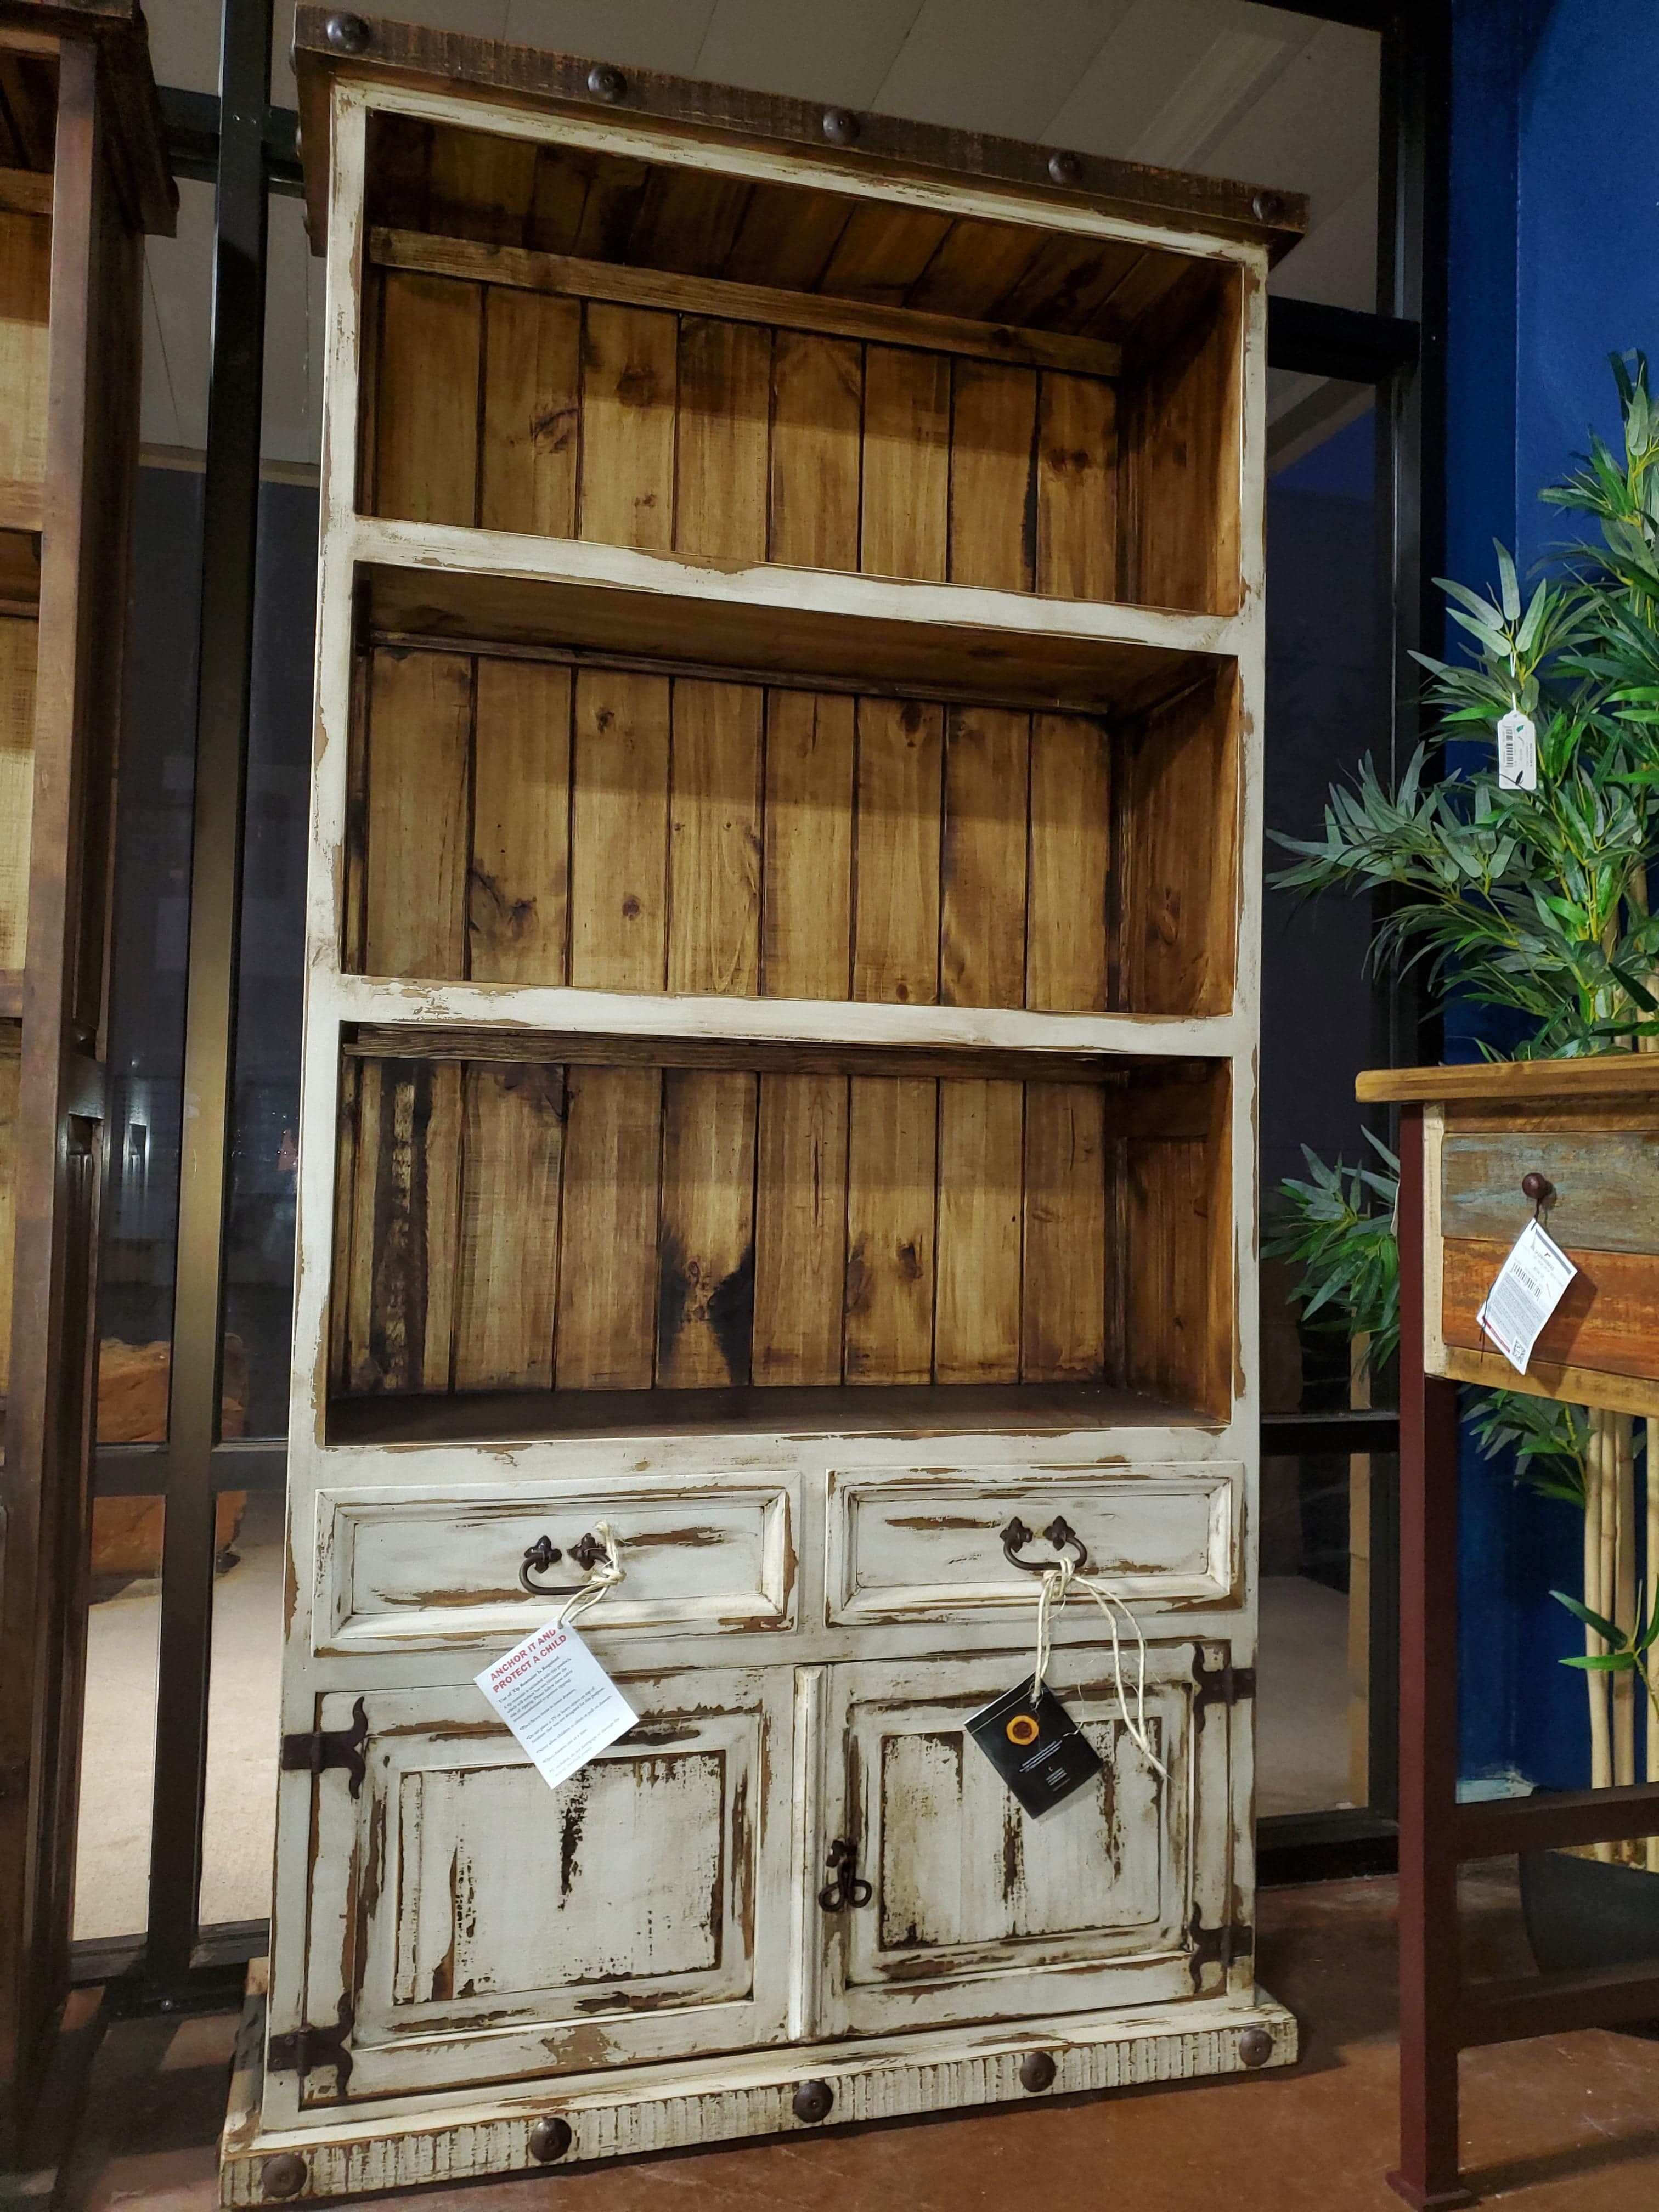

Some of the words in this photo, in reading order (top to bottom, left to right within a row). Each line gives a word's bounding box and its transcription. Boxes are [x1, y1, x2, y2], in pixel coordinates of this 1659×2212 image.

[490, 1650, 527, 1680] ANCHOR
[528, 1642, 535, 1652] IT
[538, 1629, 556, 1644] AND
[493, 1661, 532, 1693] PROTECT
[540, 1635, 567, 1656] CHILD
